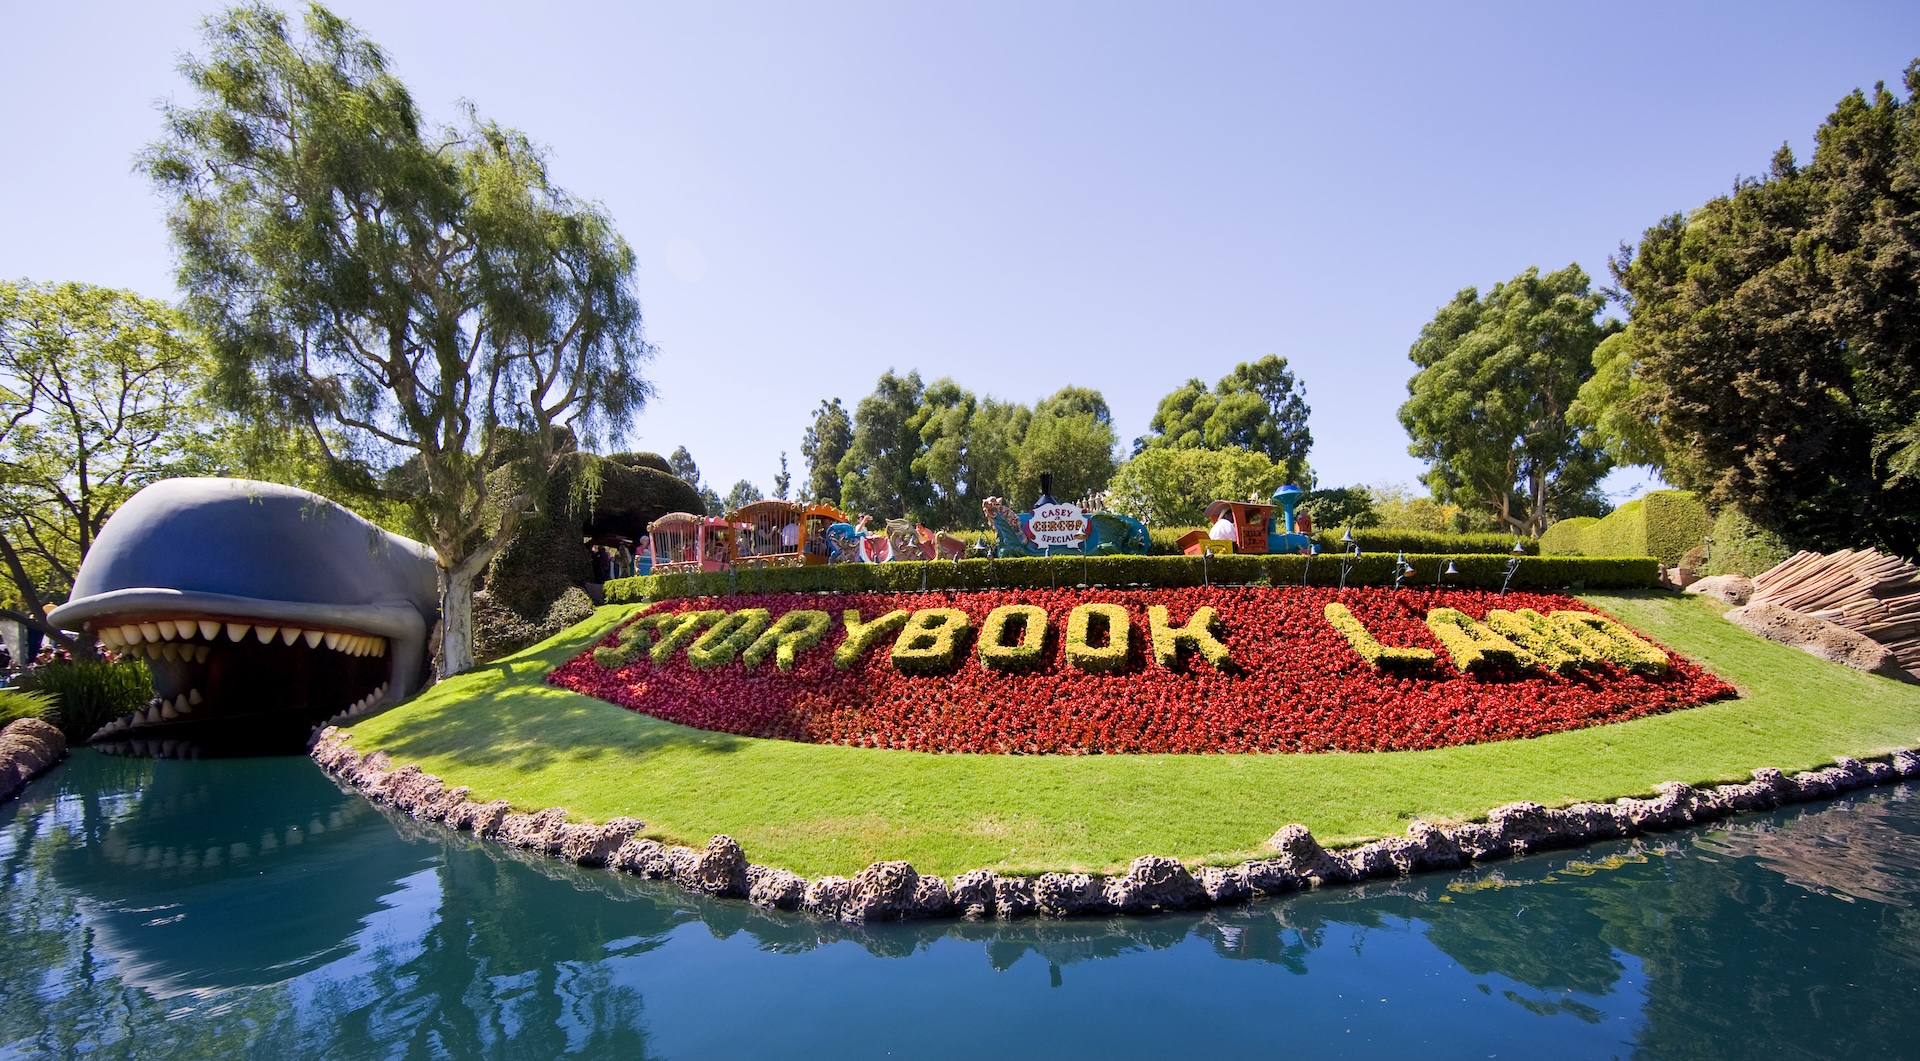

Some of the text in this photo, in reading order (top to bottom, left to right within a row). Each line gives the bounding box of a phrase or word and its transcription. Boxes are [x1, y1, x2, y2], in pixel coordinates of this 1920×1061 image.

[1041, 508, 1072, 518] CASEY
[1033, 519, 1083, 532] CIRCUS
[1041, 533, 1075, 543] SPECIAL
[593, 602, 1670, 674] STORYBOOK LAND
